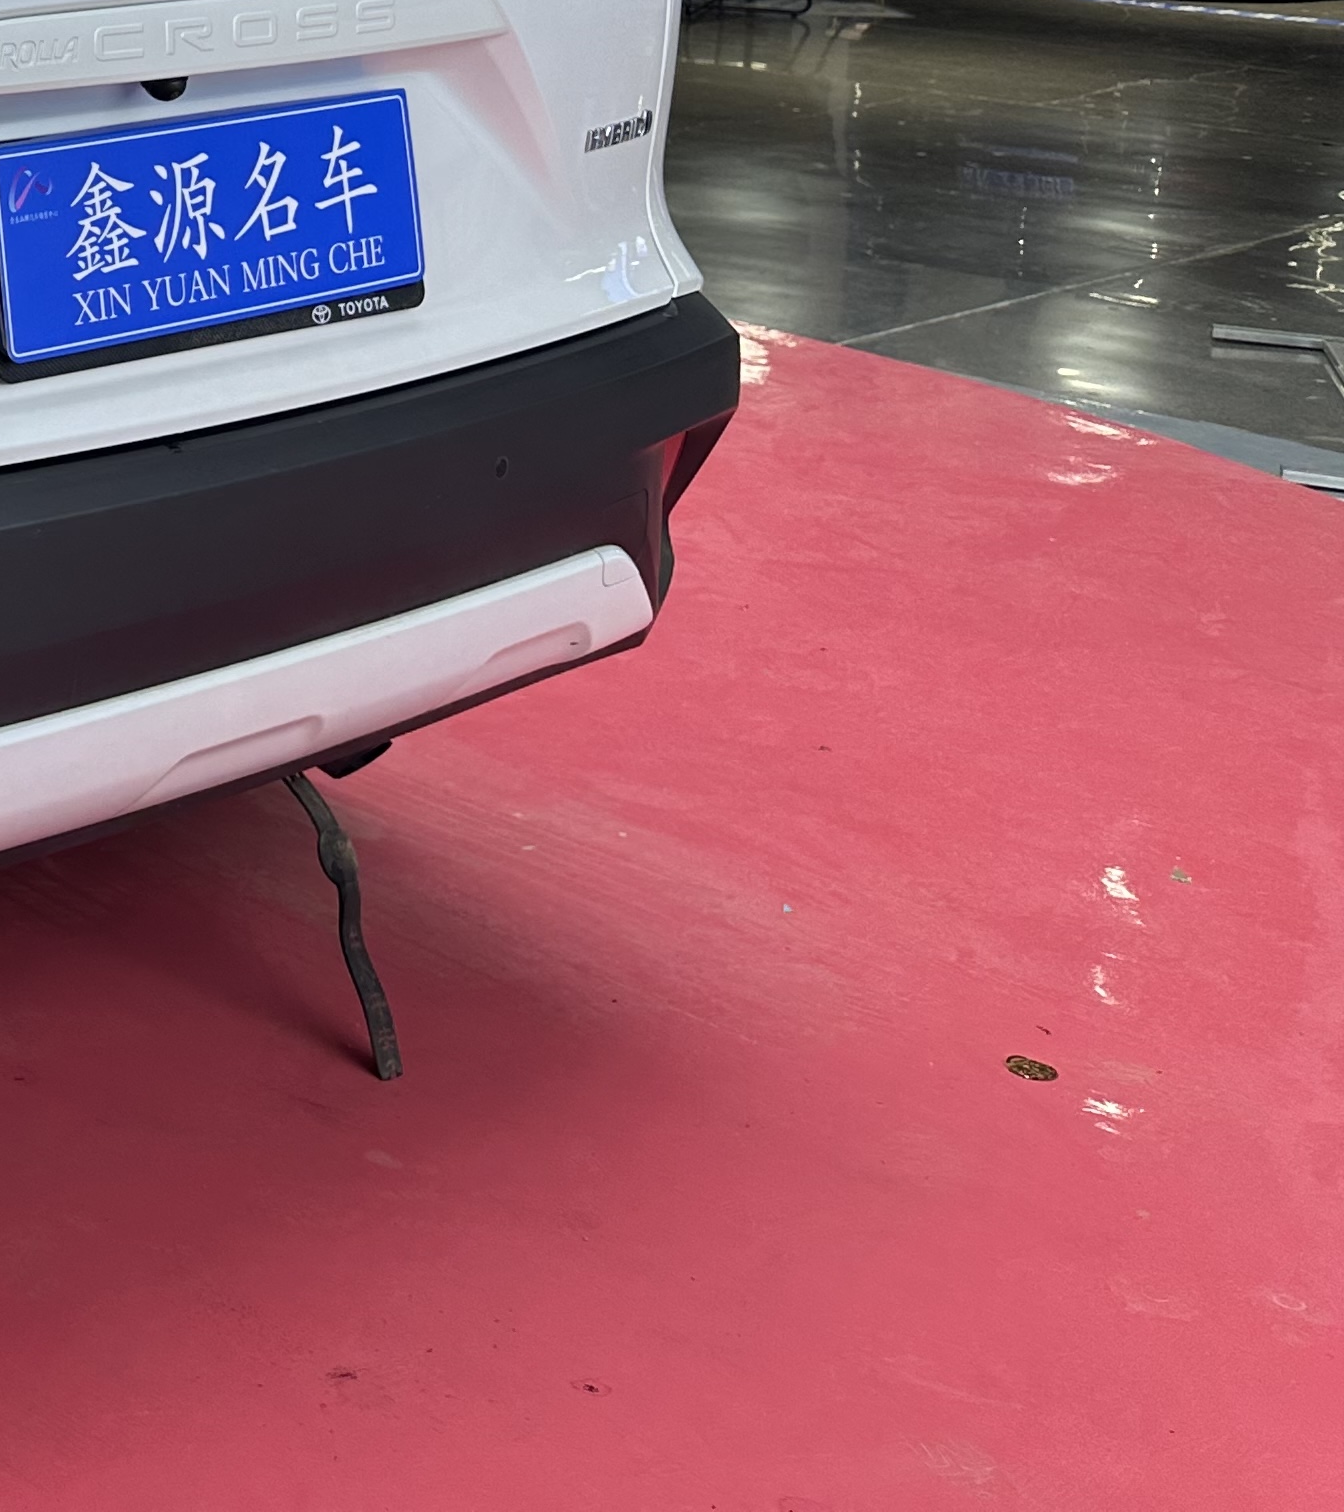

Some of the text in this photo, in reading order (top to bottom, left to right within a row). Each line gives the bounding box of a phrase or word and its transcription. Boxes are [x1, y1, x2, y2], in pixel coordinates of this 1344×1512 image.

[65, 124, 378, 281] 鑫源名车
[72, 235, 386, 326] XIN YUAN MING CHE
[338, 295, 390, 318] TOYOTA
